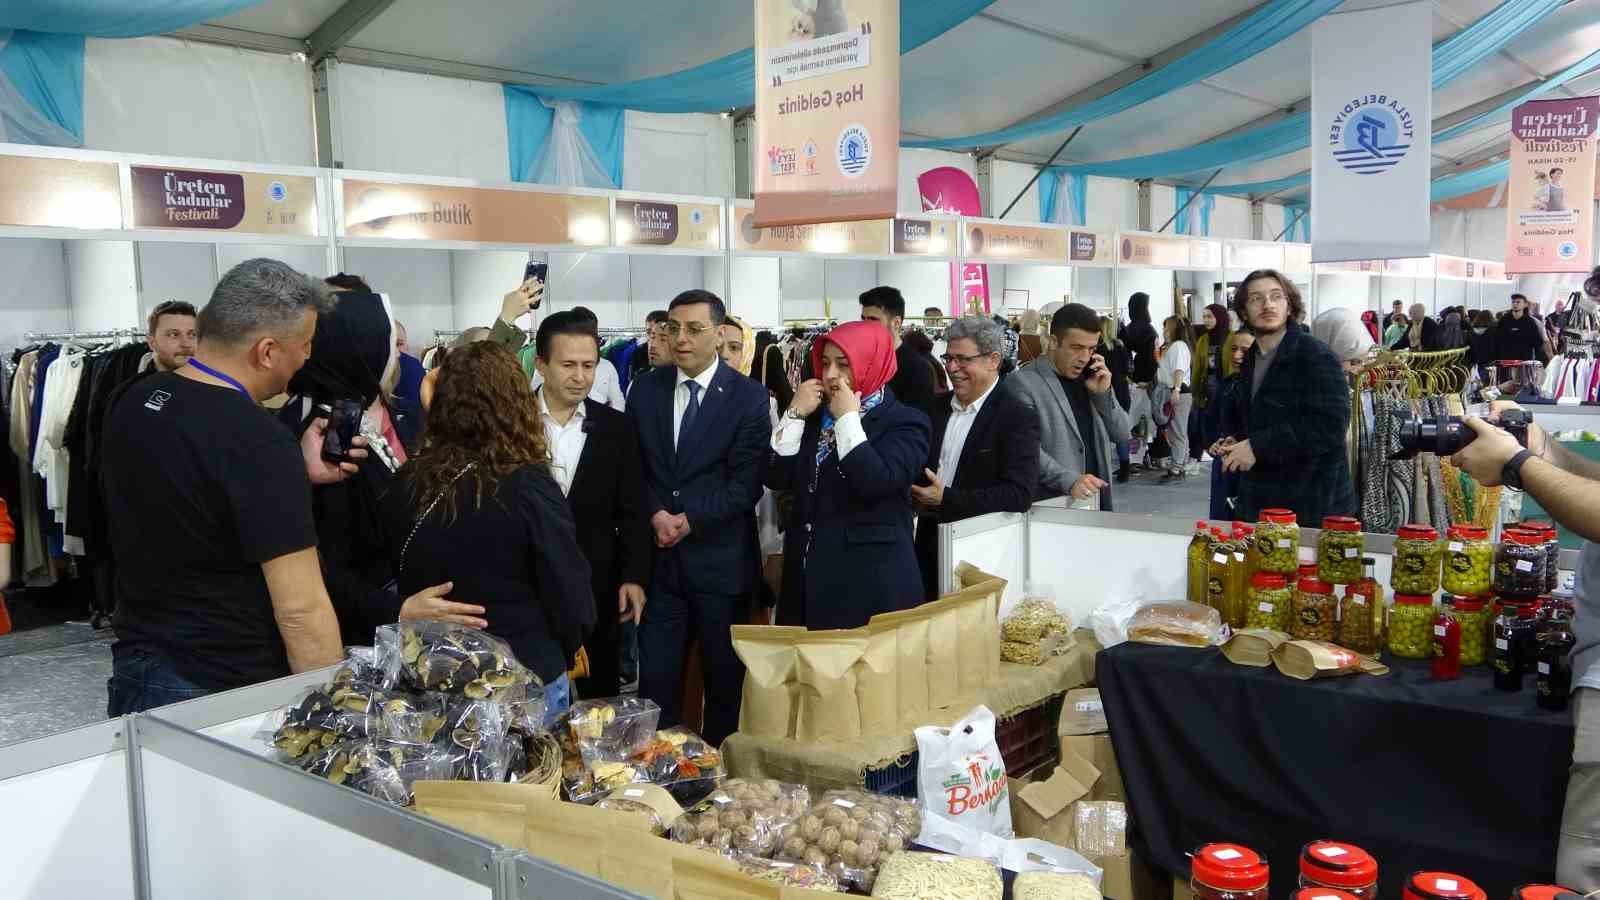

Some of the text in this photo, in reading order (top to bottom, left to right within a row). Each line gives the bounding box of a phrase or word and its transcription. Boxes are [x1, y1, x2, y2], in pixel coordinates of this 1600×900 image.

[164, 172, 226, 194] Üreten
[165, 191, 233, 209] Kadınlar
[165, 207, 219, 222] Festivali
[432, 200, 473, 225] Butik
